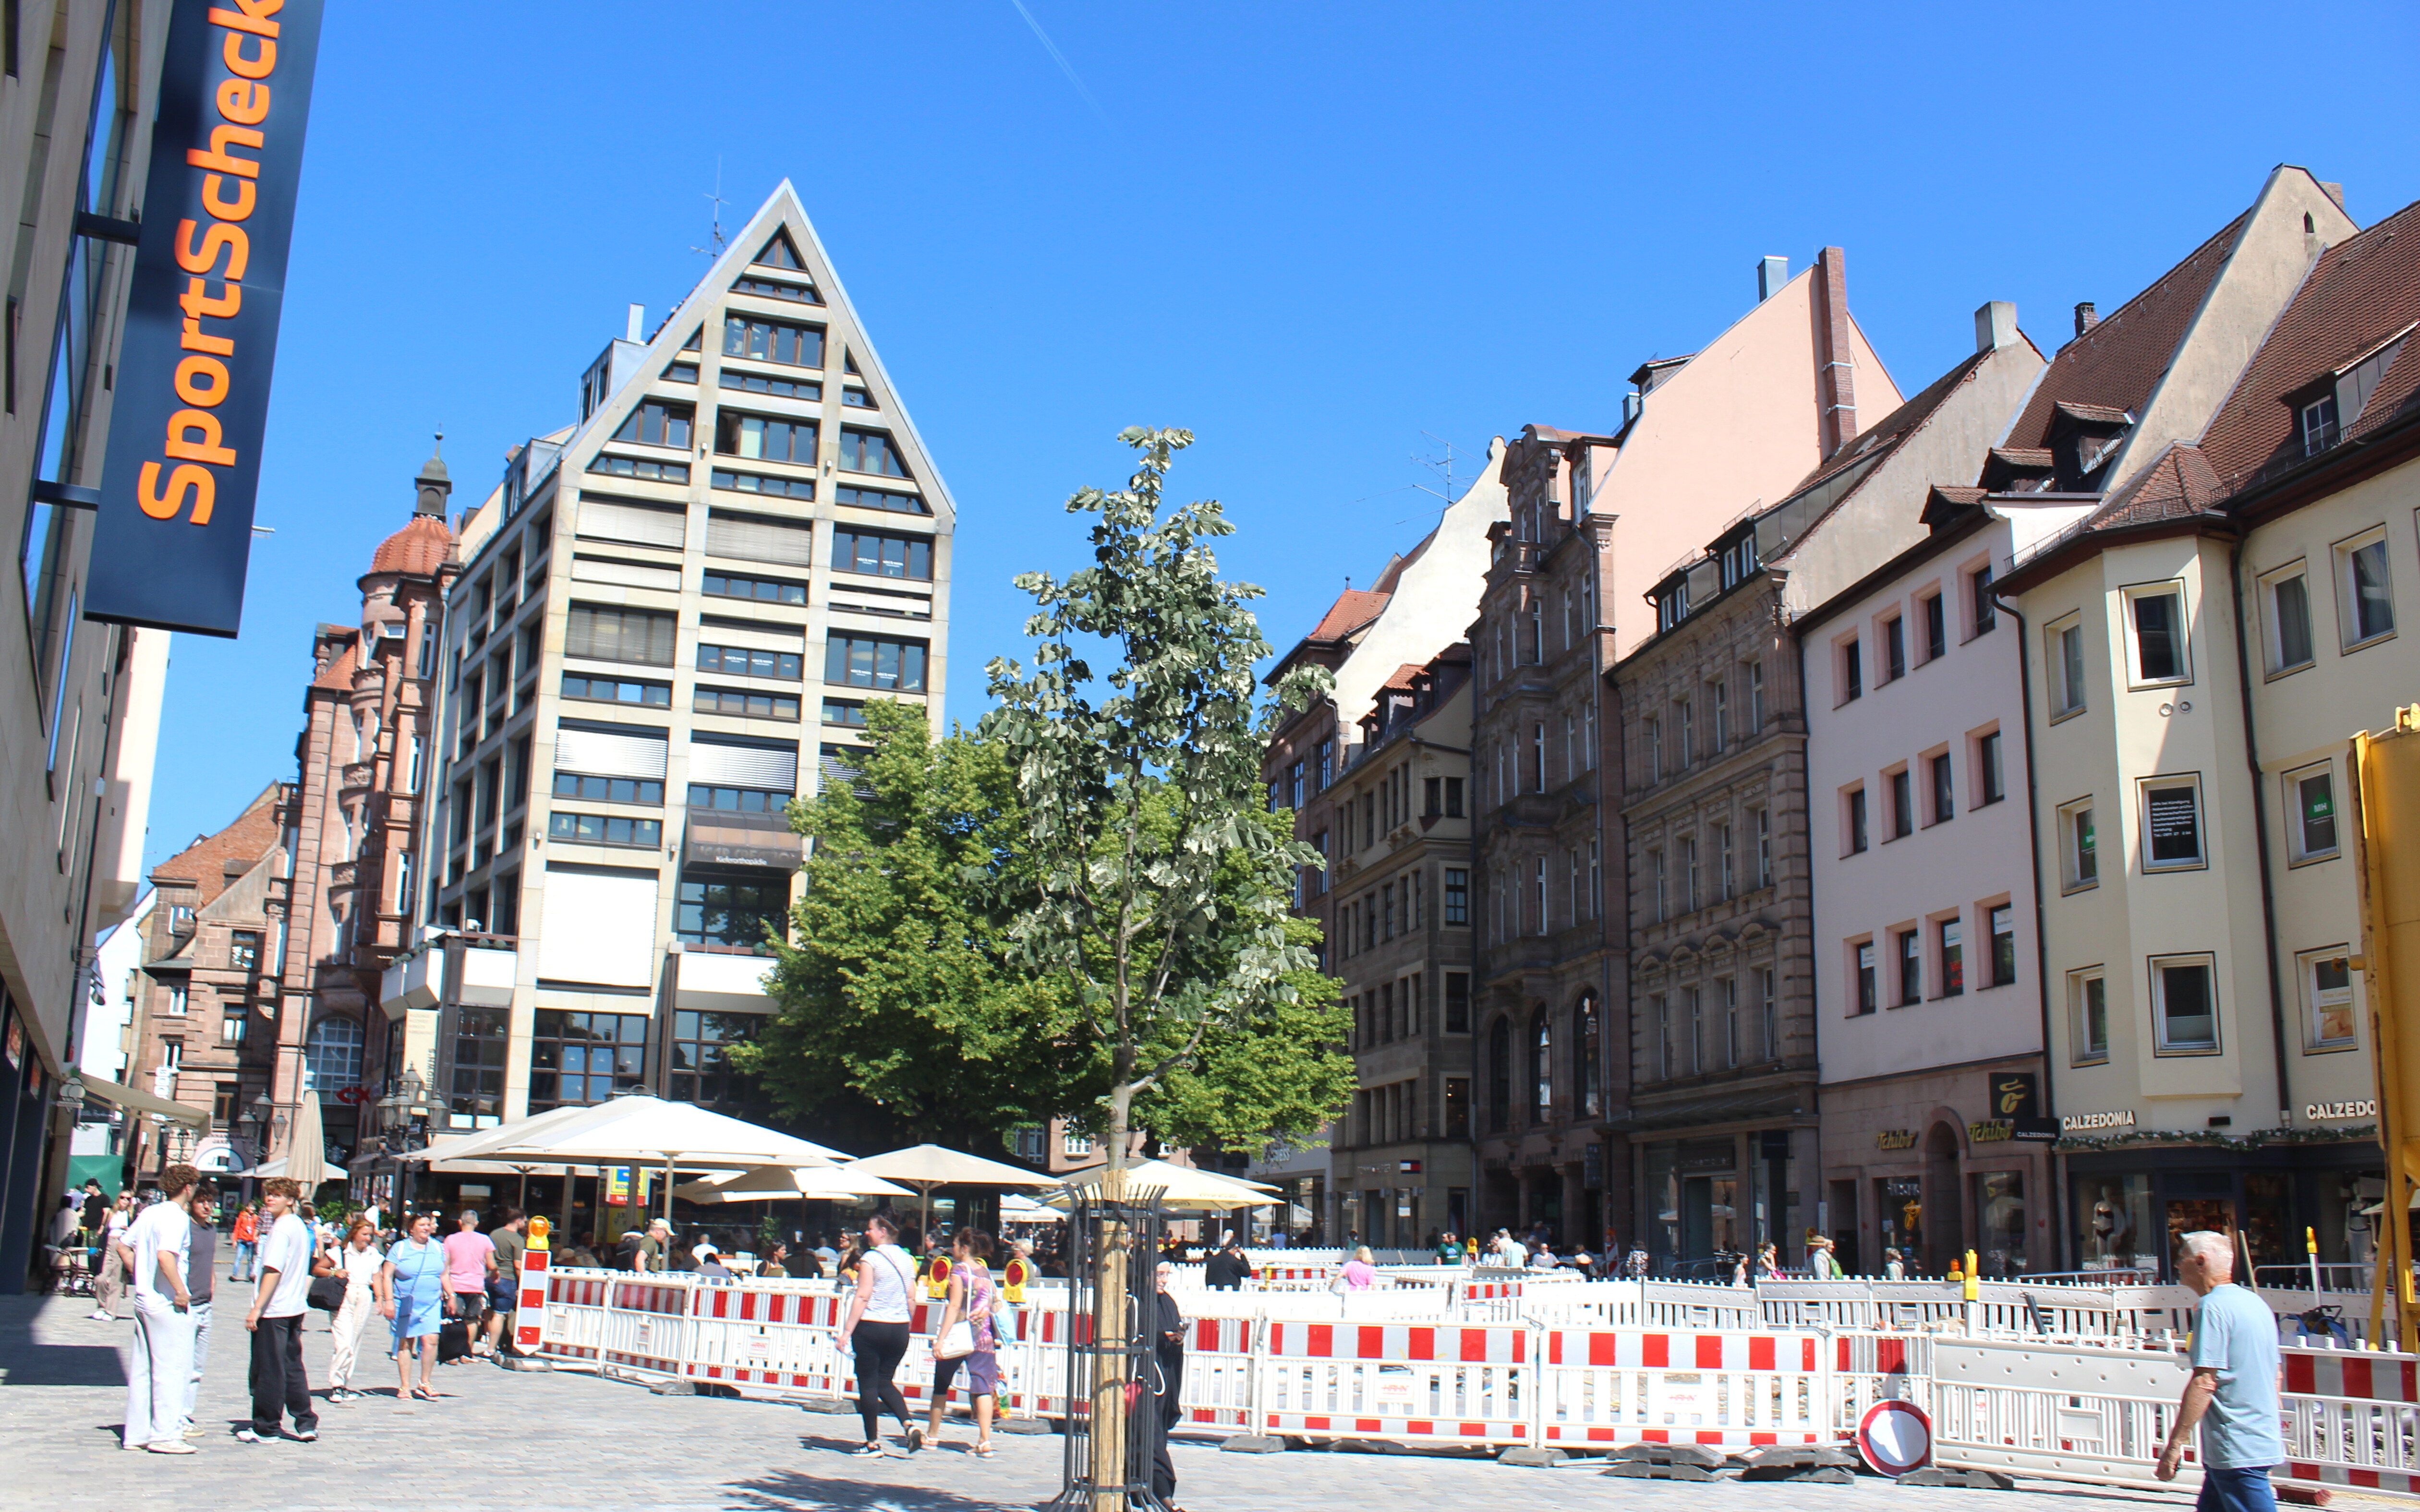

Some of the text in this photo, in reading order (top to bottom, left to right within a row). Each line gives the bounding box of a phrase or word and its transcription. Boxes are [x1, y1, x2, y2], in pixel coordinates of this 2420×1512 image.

[137, 0, 284, 526] SportScheck
[2063, 1110, 2135, 1130] CALZEDONIA
[1876, 1129, 1916, 1150] Tchibo
[1969, 1120, 2013, 1143] Tchibo
